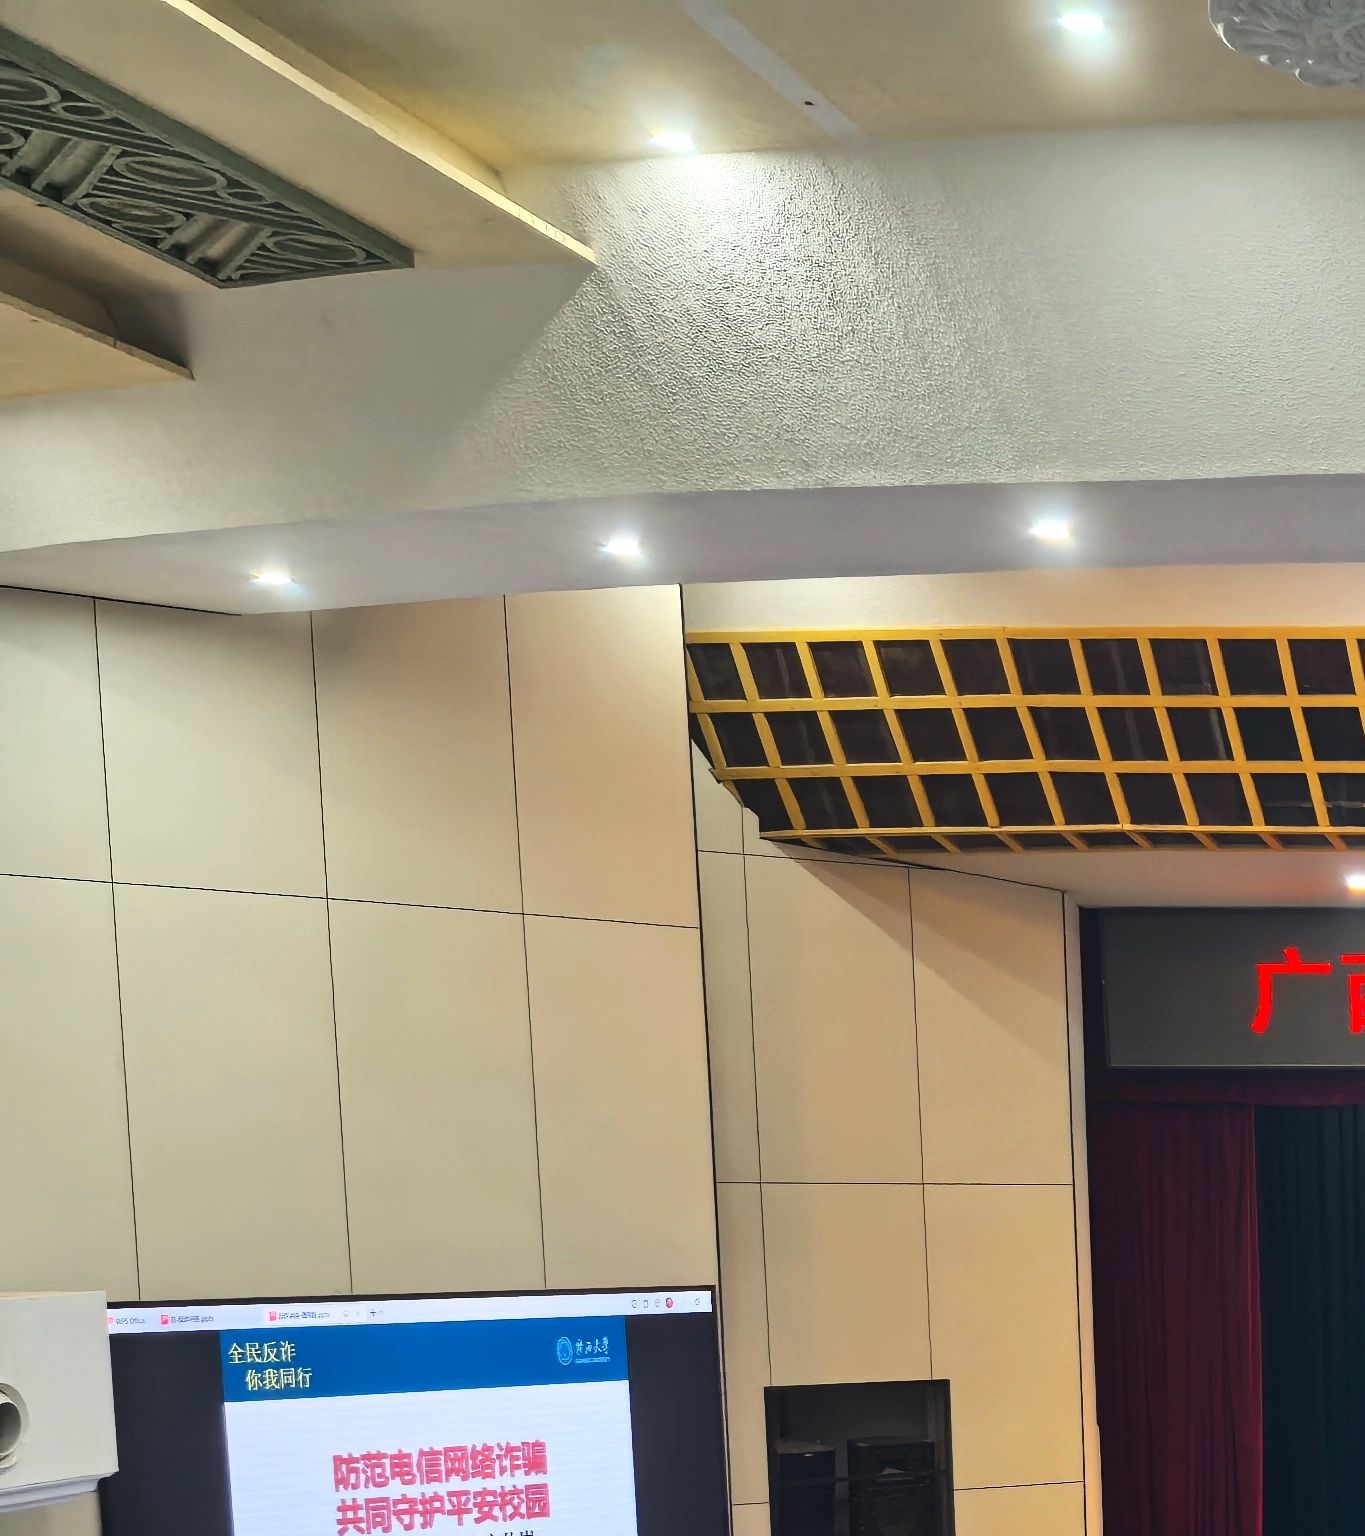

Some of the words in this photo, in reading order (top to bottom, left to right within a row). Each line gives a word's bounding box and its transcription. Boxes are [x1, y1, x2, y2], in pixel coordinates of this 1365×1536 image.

[228, 1341, 297, 1366] 全民反诈
[245, 1367, 312, 1392] 你我同行
[333, 1439, 549, 1494] 防范电信网络诈骗
